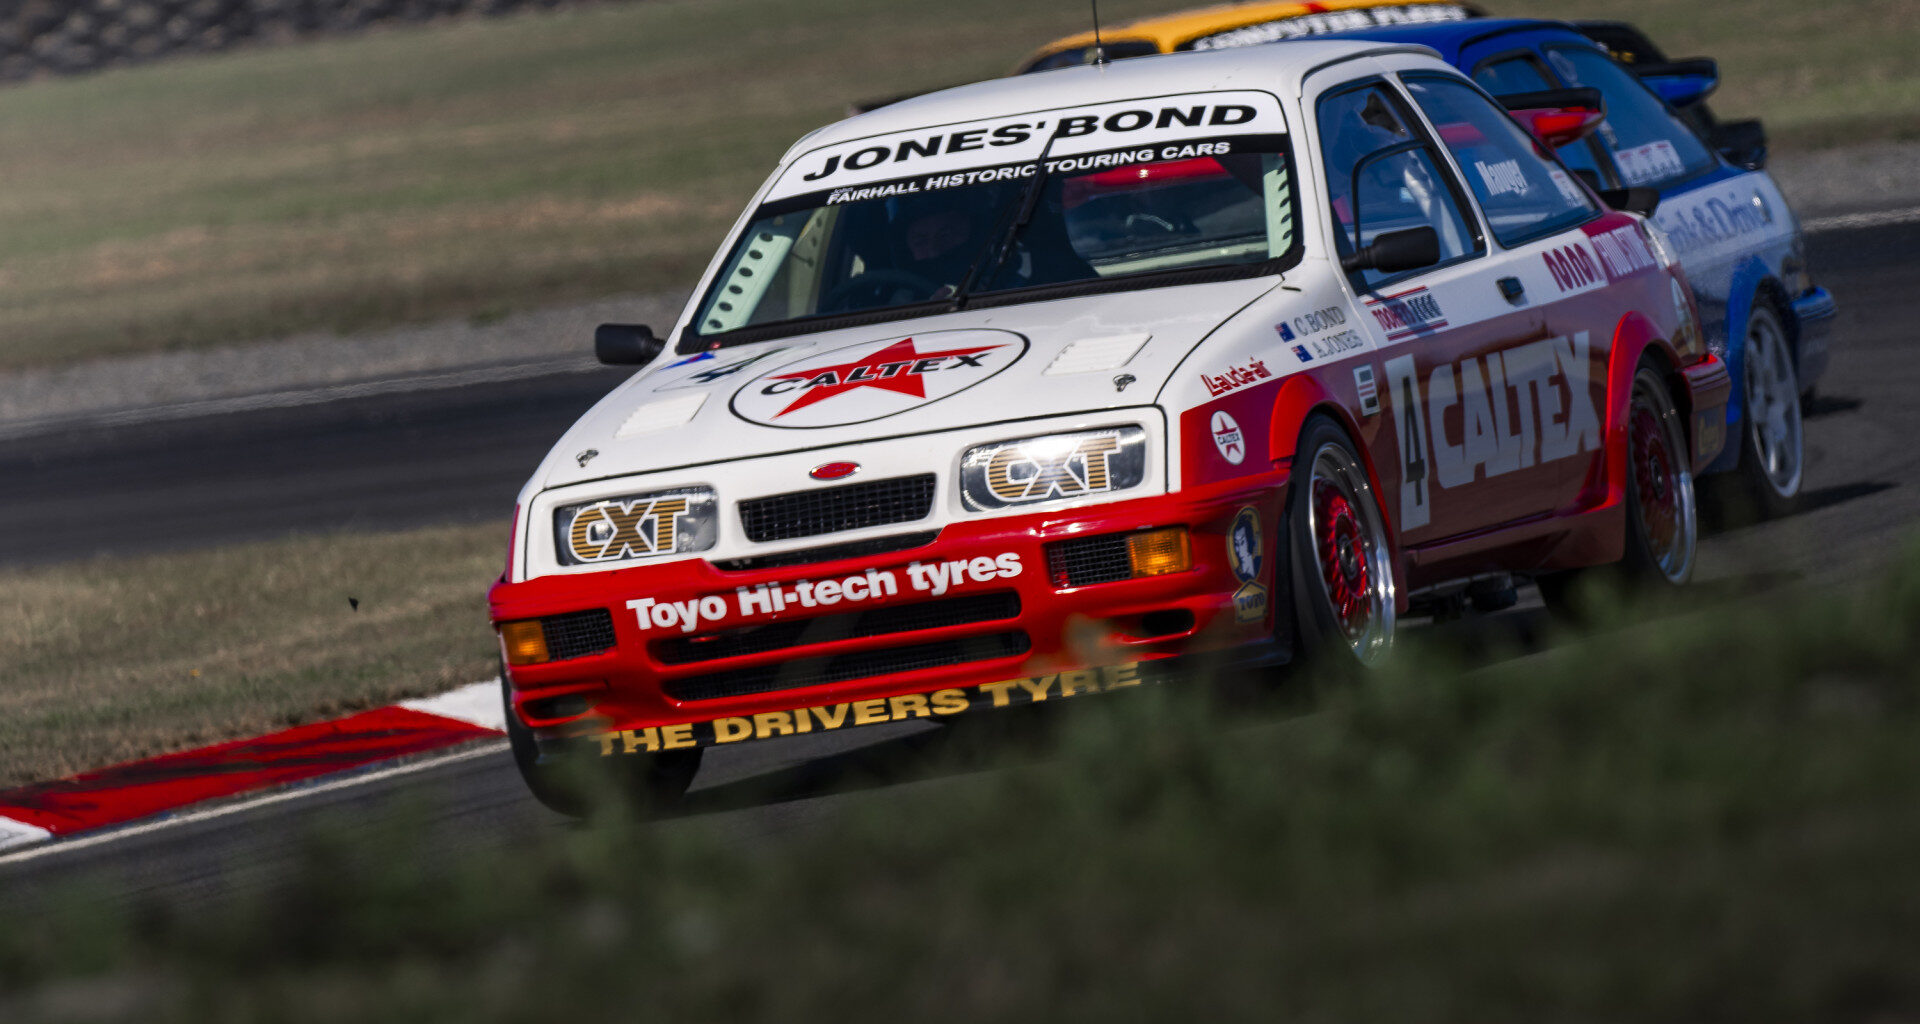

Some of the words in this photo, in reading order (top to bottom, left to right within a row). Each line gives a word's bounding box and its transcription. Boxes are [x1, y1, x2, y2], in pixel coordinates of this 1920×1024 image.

[826, 181, 920, 206] FAIRHALL
[926, 163, 1038, 191] HISTORIC
[1045, 149, 1155, 174] TOURING
[1162, 141, 1231, 160] CARS
[761, 353, 992, 396] CALTEX
[1402, 375, 1426, 506] 4
[1428, 330, 1602, 490] CALTEX
[985, 434, 1122, 503] CXT
[569, 494, 690, 563] CXT
[626, 596, 728, 633] Toyo
[737, 569, 897, 616] Hi-tech
[907, 552, 1023, 596] tyres
[589, 723, 698, 755] THE
[713, 688, 970, 745] DRIVERS
[979, 661, 1143, 707] TYRE
